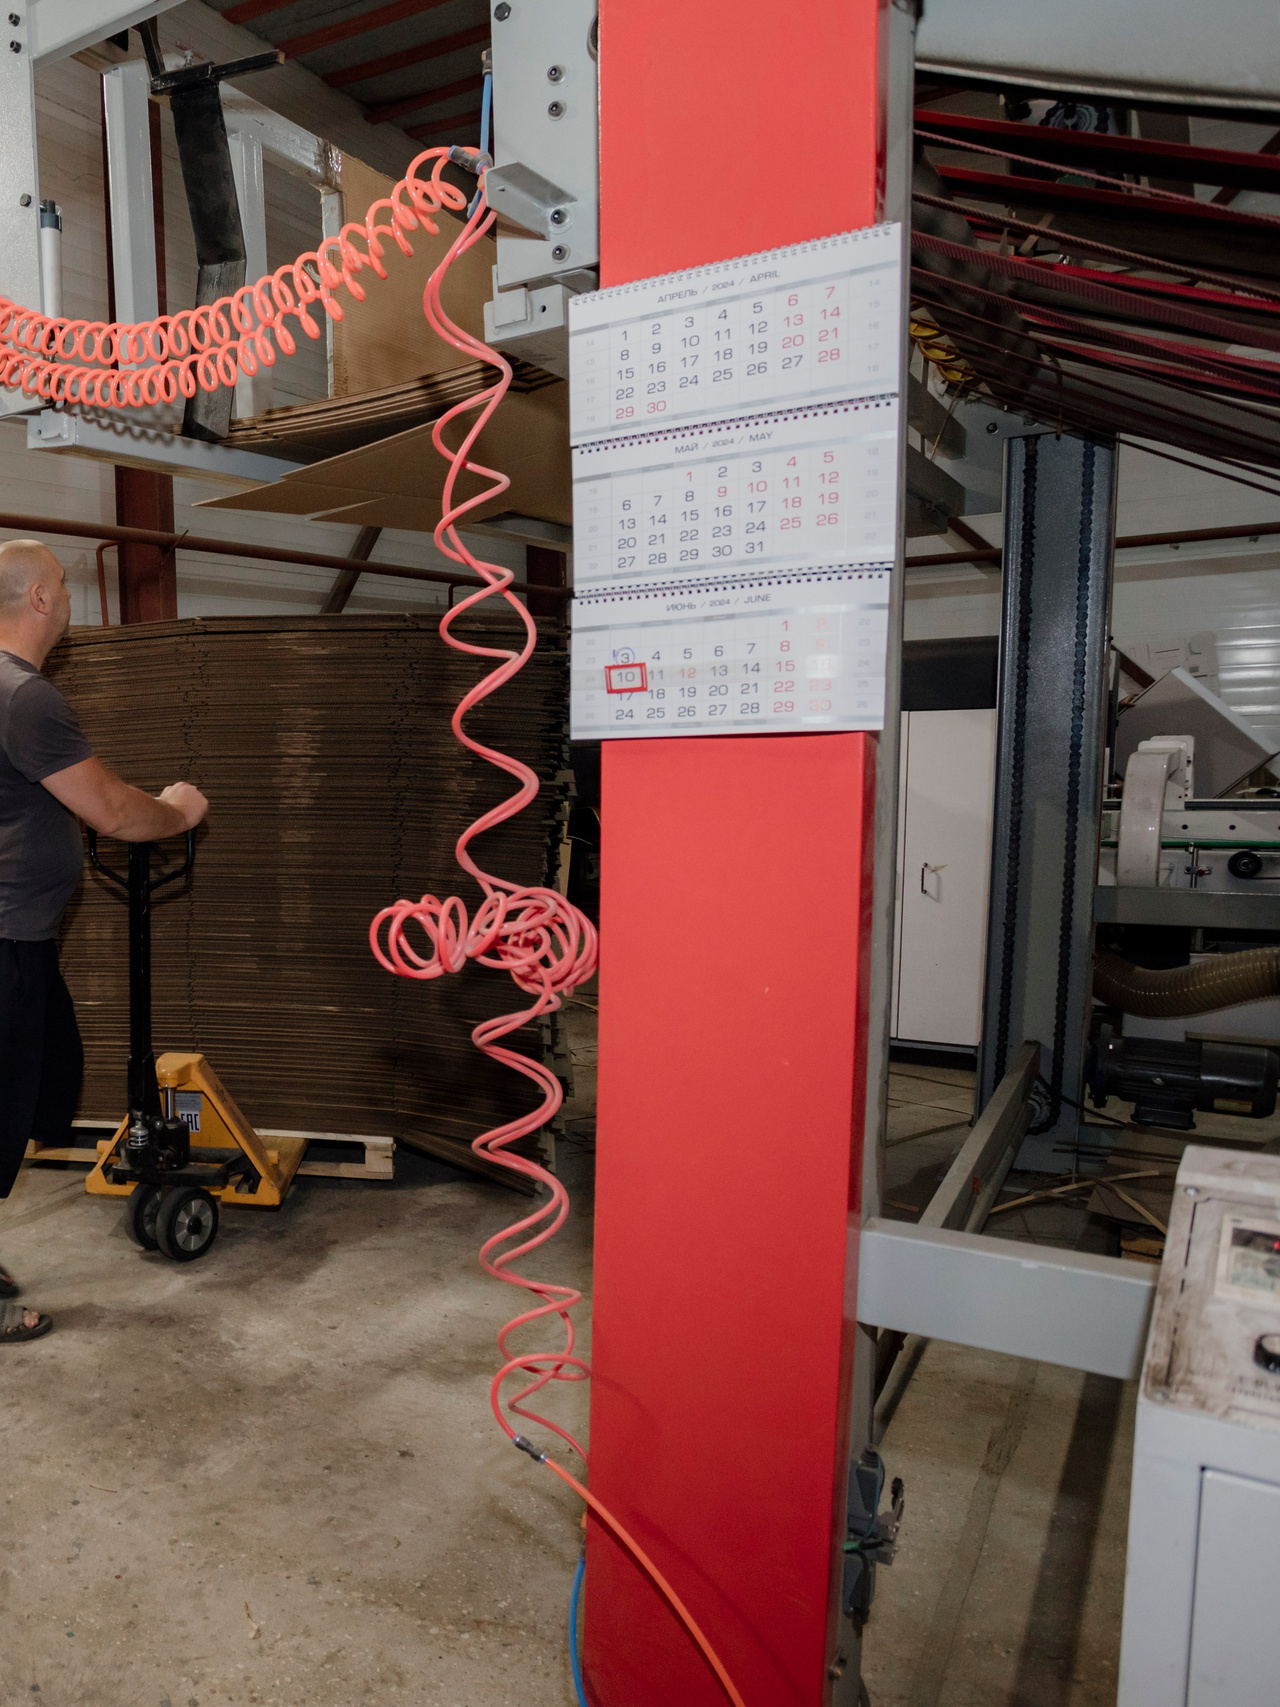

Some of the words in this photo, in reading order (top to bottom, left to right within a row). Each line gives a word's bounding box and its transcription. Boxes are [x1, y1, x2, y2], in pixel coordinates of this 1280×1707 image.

[657, 289, 698, 304] АПРЕЛЬ
[712, 280, 735, 291] 2024
[750, 270, 780, 283] APRIL
[622, 330, 627, 340] 1
[652, 323, 661, 335] 2
[685, 316, 694, 328] 3
[718, 309, 727, 319] 4
[753, 302, 763, 314] 5
[788, 294, 798, 306] 6
[825, 286, 835, 299] 7
[620, 349, 629, 361] 8
[652, 343, 661, 354] 9
[681, 335, 700, 348] 10
[715, 328, 730, 341] 11
[749, 321, 768, 334] 12
[784, 314, 803, 327] 13
[821, 306, 840, 320] 14
[617, 368, 634, 380] 15
[649, 361, 666, 374] 16
[681, 355, 699, 367] 17
[715, 348, 733, 361] 18
[749, 341, 768, 354] 19
[782, 334, 804, 349] 20
[819, 327, 838, 342] 21
[616, 387, 634, 400] 22
[647, 381, 666, 394] 23
[679, 375, 699, 388] 24
[713, 368, 733, 382] 25
[747, 362, 767, 376] 26
[782, 355, 803, 369] 27
[818, 348, 840, 363] 28
[616, 406, 634, 419] 29
[647, 400, 666, 413] 30
[675, 442, 699, 454] МАЙ
[712, 438, 735, 448] 2024
[749, 432, 773, 443] MAY
[687, 471, 692, 482] 1
[718, 466, 727, 478] 2
[752, 461, 762, 473] 3
[787, 456, 797, 467] 4
[824, 451, 834, 463] 5
[622, 500, 631, 511] 6
[654, 495, 662, 506] 7
[685, 491, 694, 502] 8
[718, 486, 727, 497] 9
[748, 480, 767, 493] 10
[783, 476, 799, 488] 11
[820, 471, 839, 484] 12
[619, 518, 636, 529] 13
[650, 514, 666, 525] 14
[682, 509, 699, 521] 15
[714, 505, 732, 517] 16
[748, 500, 766, 513] 17
[783, 496, 802, 509] 18
[819, 492, 839, 504] 19
[618, 537, 636, 549] 20
[648, 533, 665, 546] 21
[680, 529, 699, 542] 22
[712, 525, 732, 538] 23
[746, 521, 766, 534] 24
[780, 517, 801, 530] 25
[816, 513, 838, 526] 26
[618, 556, 636, 569] 27
[649, 552, 667, 565] 28
[680, 549, 699, 561] 29
[712, 545, 732, 557] 30
[745, 541, 763, 553] 31
[666, 602, 697, 612] ИЮНЬ
[709, 598, 731, 608] 2024
[743, 593, 772, 604] JUNE
[782, 620, 788, 631] 1
[621, 652, 630, 664] 3
[652, 651, 660, 661] 4
[683, 648, 692, 659] 5
[714, 646, 723, 657] 6
[747, 643, 756, 654] 7
[780, 640, 790, 652] 8
[617, 671, 635, 682] 10
[648, 669, 664, 680] 11
[680, 667, 696, 678] 12
[711, 665, 728, 676] 13
[743, 663, 760, 674] 14
[776, 660, 795, 672] 15
[647, 688, 665, 699] 18
[680, 687, 696, 698] 19
[709, 684, 728, 696] 20
[741, 683, 758, 694] 21
[774, 680, 794, 693] 22
[616, 709, 634, 720] 24
[647, 707, 665, 719] 25
[678, 706, 696, 717] 26
[708, 704, 727, 716] 27
[740, 702, 760, 714] 28
[773, 701, 794, 713] 29
